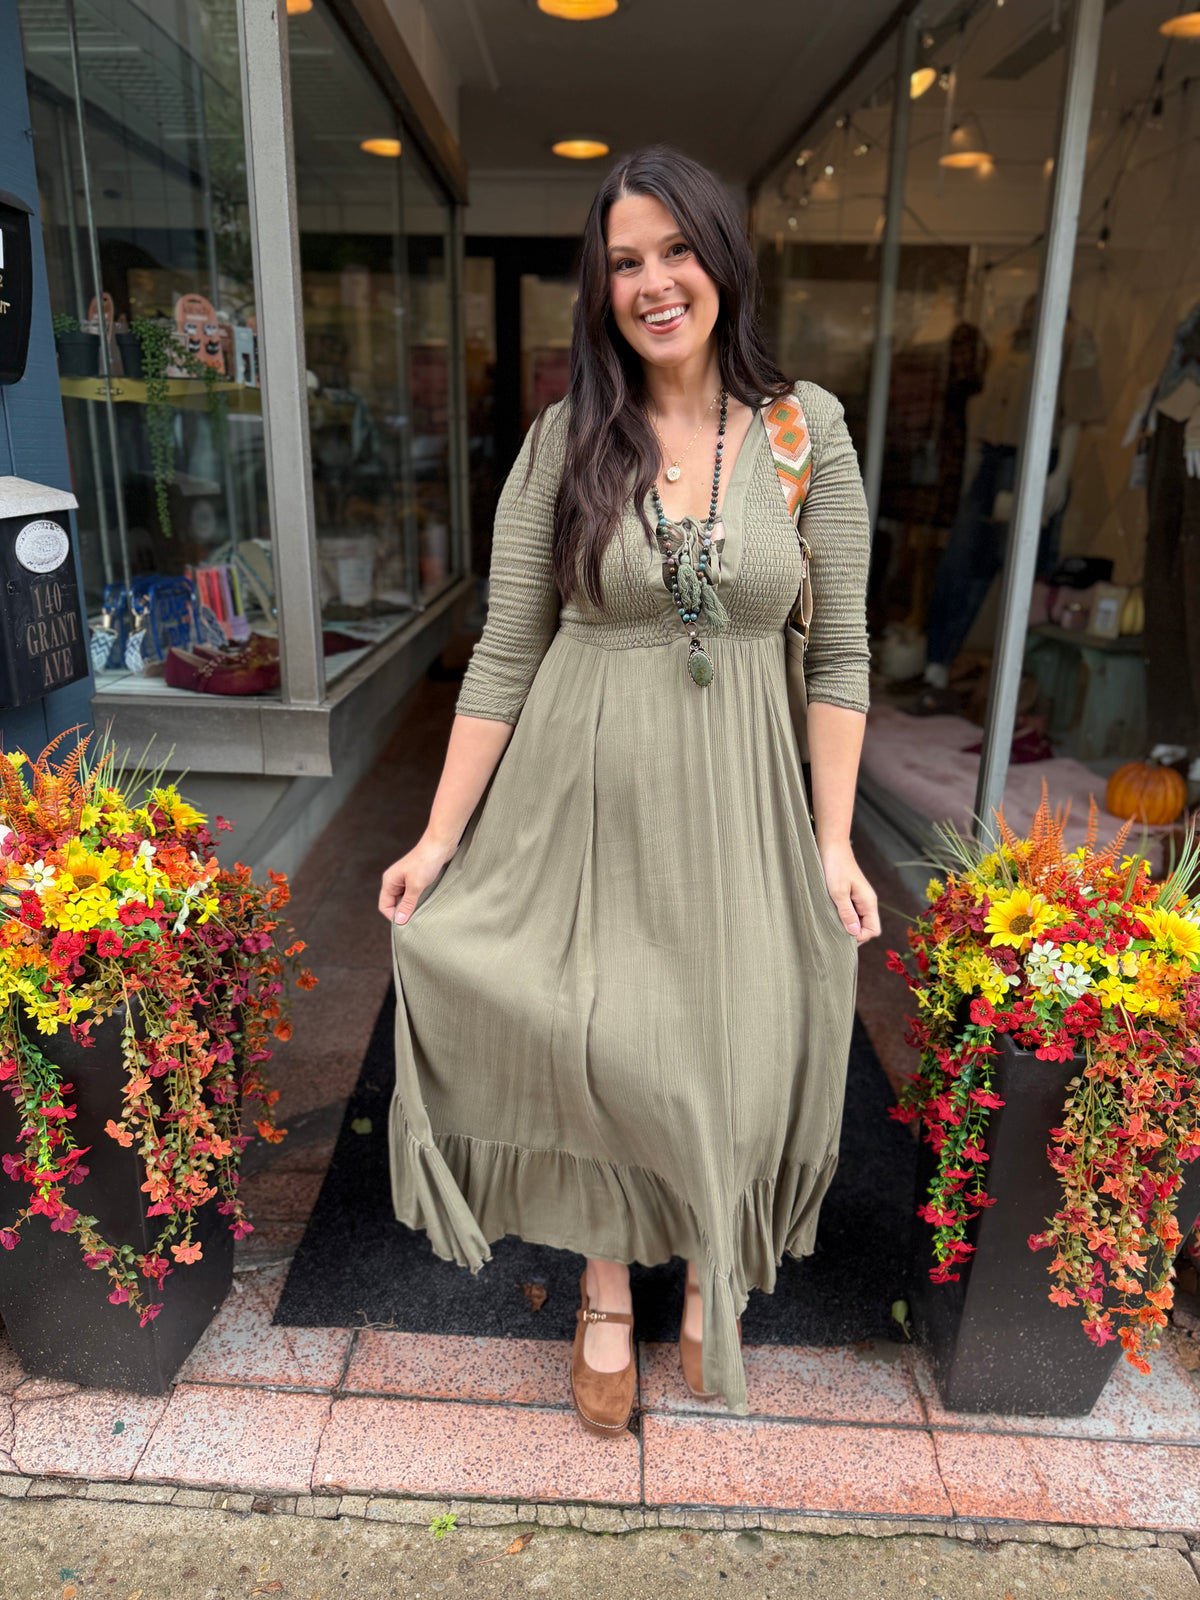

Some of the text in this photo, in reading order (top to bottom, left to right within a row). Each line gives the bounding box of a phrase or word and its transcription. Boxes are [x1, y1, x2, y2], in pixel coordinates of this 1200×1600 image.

[34, 582, 62, 618] 140
[26, 612, 77, 656] GRANT
[43, 647, 74, 687] AVE
